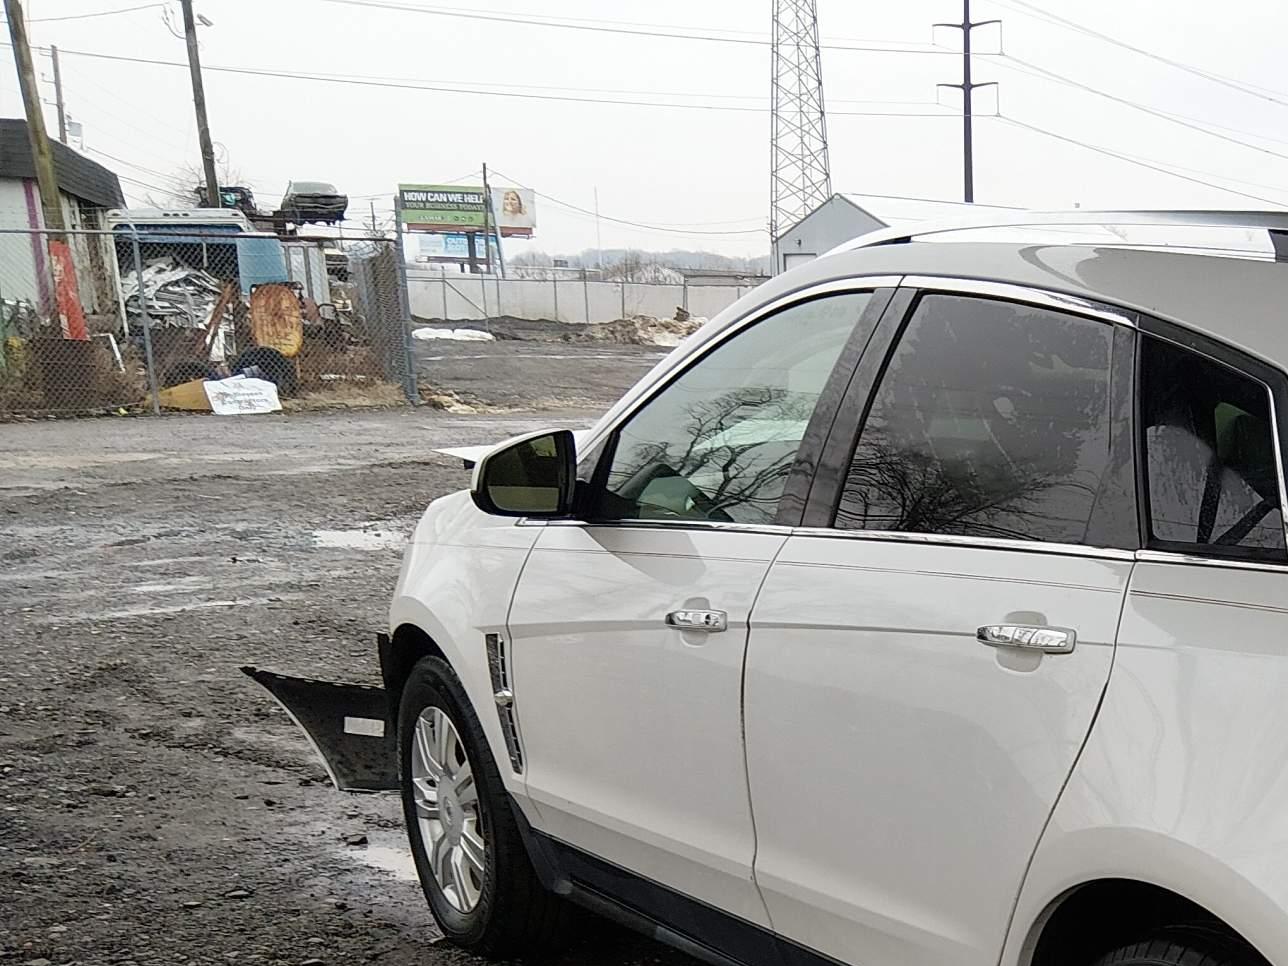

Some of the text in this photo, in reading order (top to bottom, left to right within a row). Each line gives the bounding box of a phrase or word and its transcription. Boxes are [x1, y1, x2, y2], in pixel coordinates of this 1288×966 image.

[403, 192, 427, 202] HOW
[427, 192, 447, 203] CAN
[447, 193, 464, 203] WE
